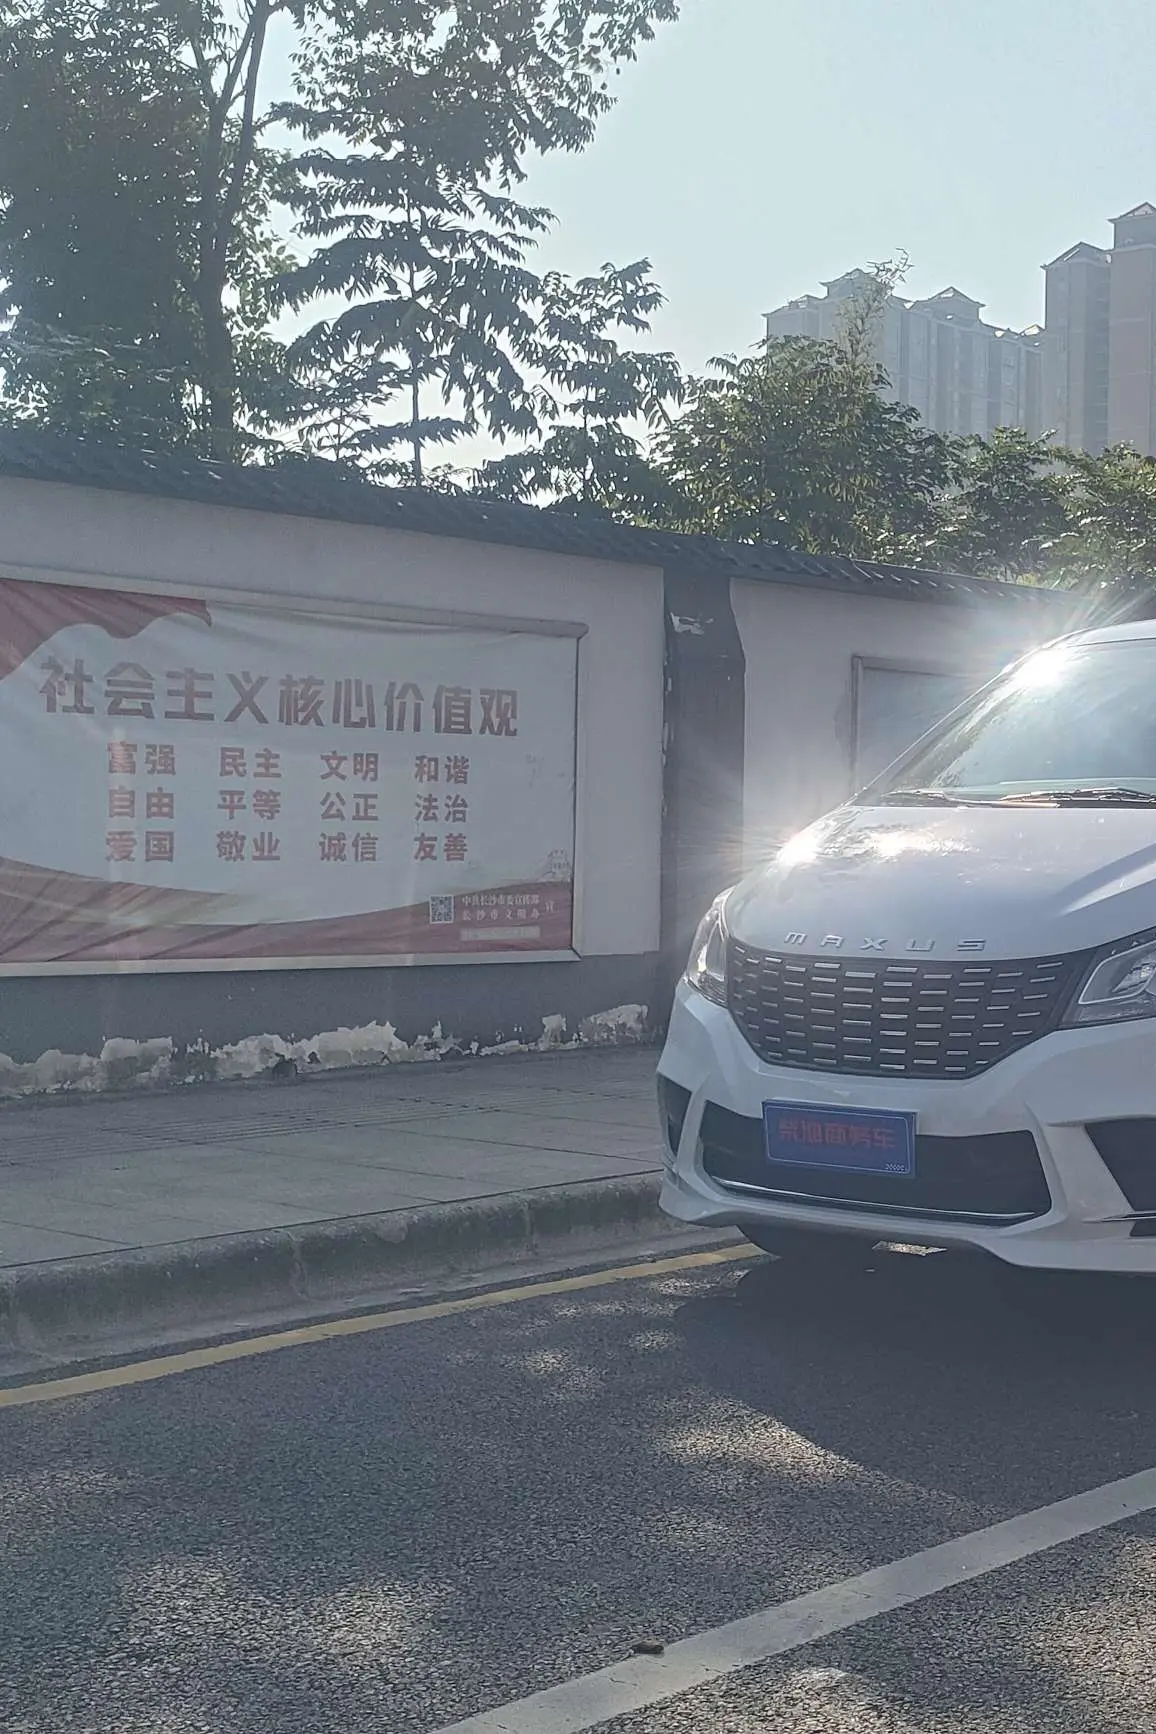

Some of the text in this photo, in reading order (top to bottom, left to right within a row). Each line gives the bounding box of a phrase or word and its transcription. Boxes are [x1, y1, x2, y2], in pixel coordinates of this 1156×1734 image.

[39, 657, 518, 737] 社会主义核心价值观
[107, 742, 471, 786] 富强 民主 文明 和谐
[108, 786, 470, 824] 自由 平等 公正 法治
[105, 830, 469, 864] 爱国 敬业 诚信 友善
[783, 930, 987, 953] MAXUS
